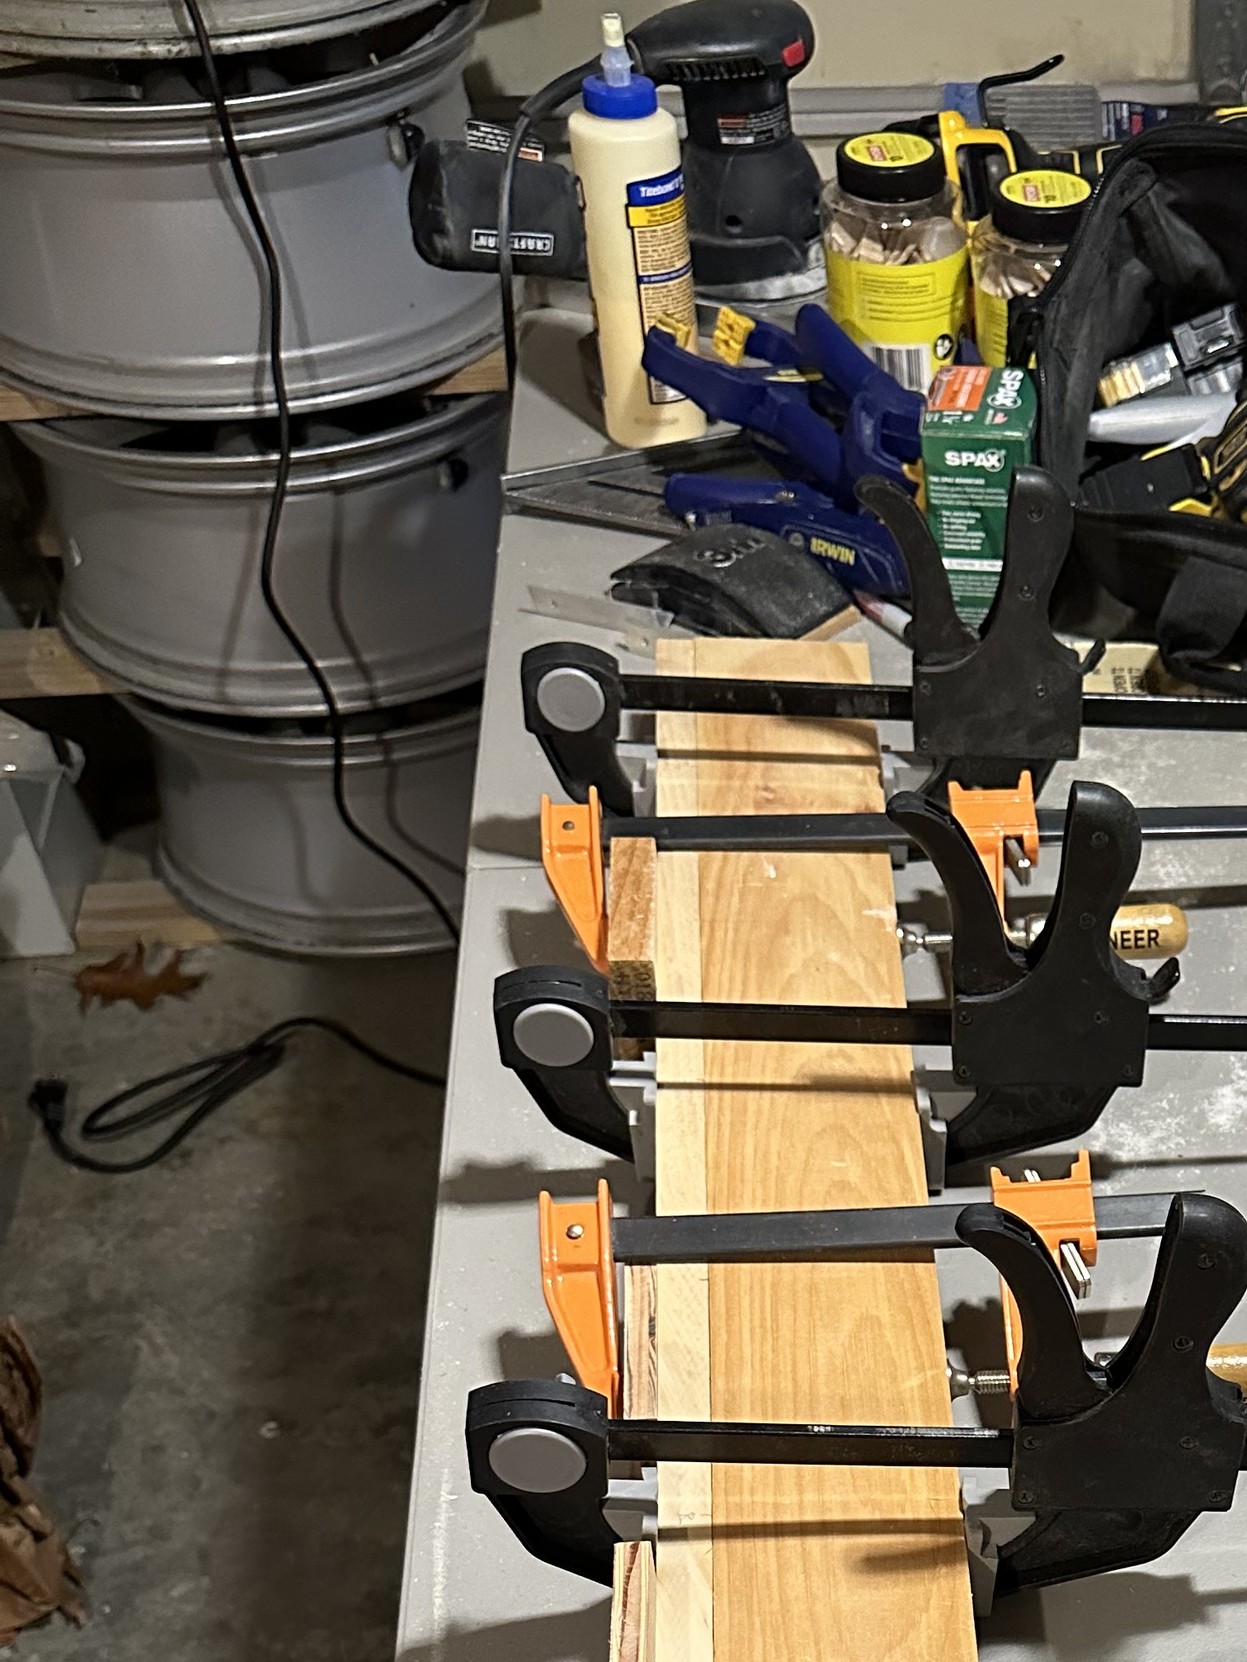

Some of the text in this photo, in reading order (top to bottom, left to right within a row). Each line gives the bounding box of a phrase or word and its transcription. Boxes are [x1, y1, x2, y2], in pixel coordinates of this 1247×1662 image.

[988, 369, 1024, 408] SPAX
[945, 450, 1003, 469] SPAX
[810, 537, 856, 566] IRWIN
